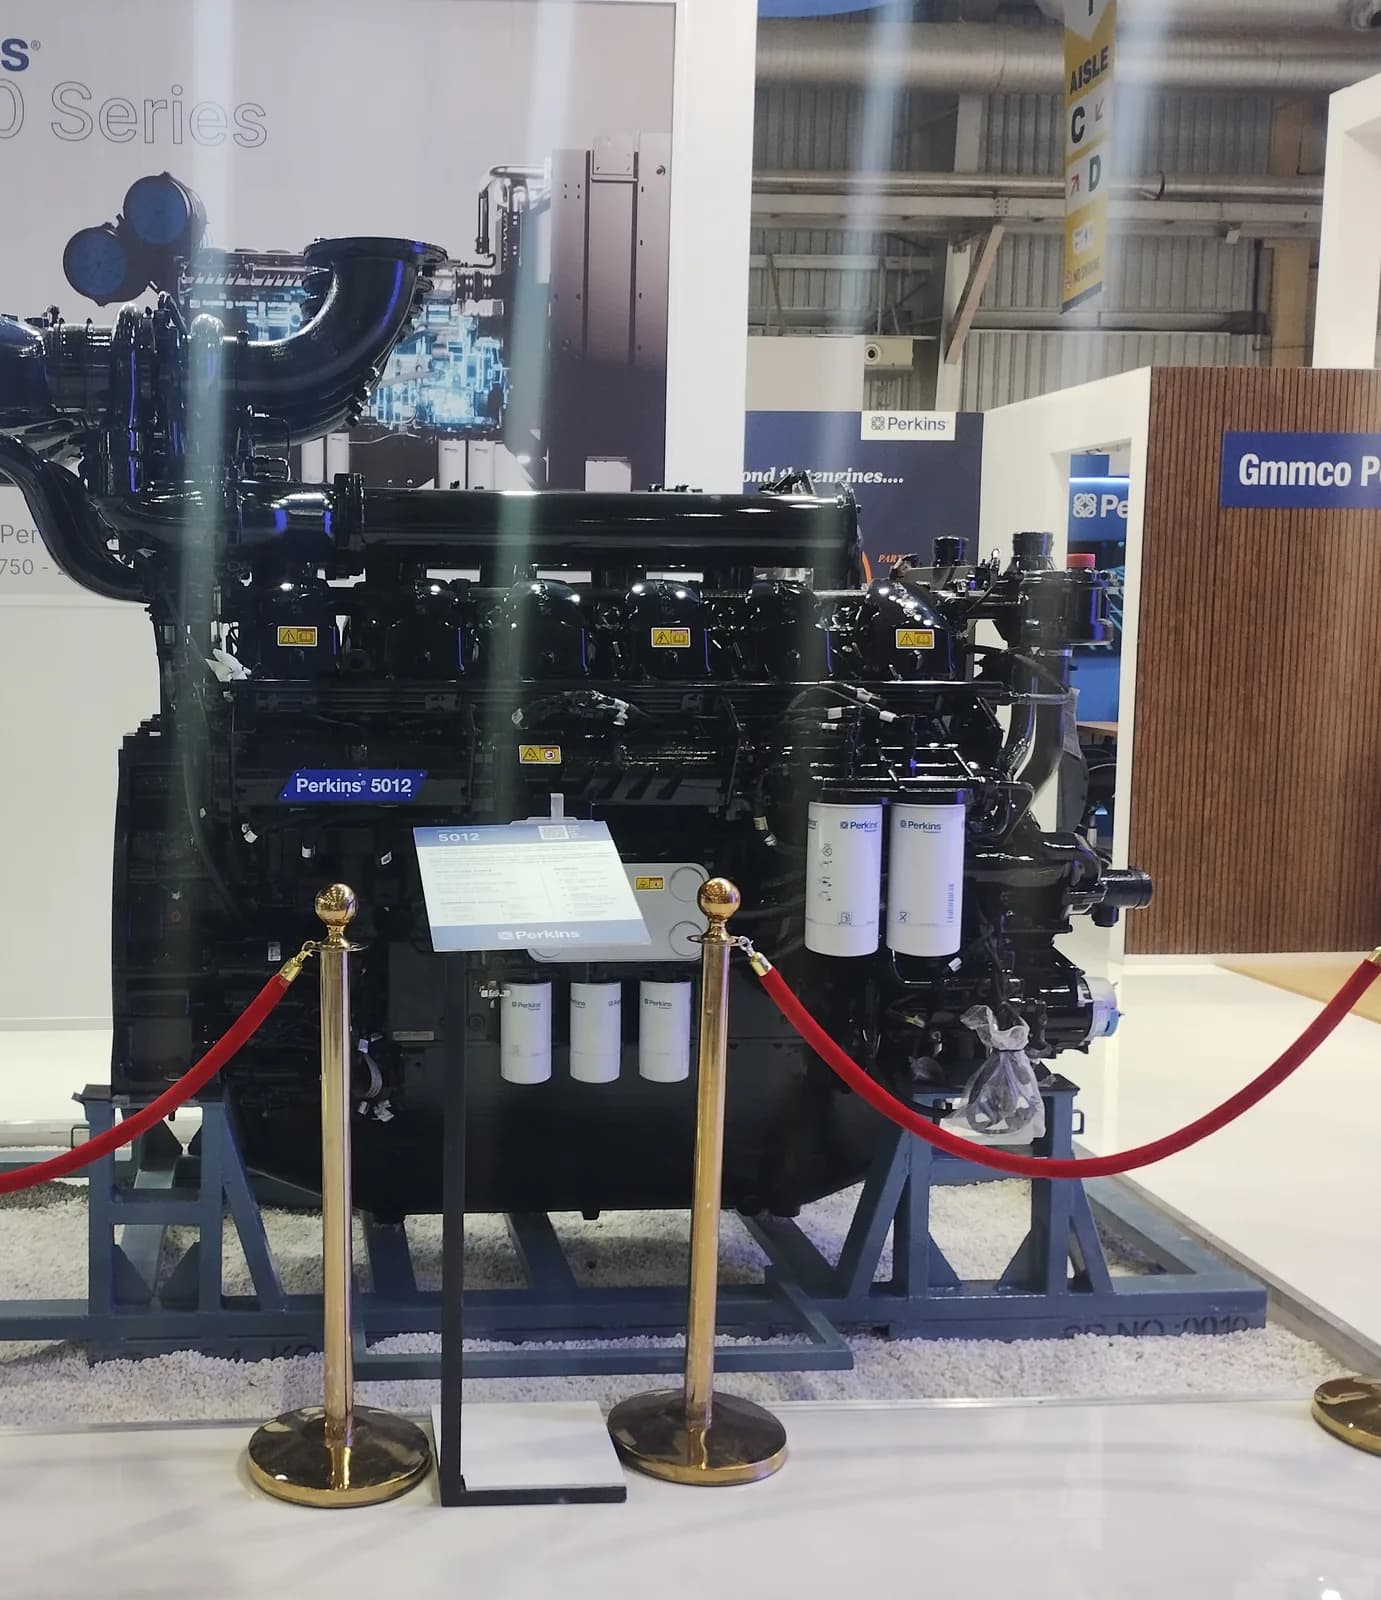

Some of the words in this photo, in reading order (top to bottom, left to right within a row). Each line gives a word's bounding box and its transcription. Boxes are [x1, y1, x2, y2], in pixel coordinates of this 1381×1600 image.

[1070, 45, 1109, 96] AISLE
[51, 81, 268, 148] Series
[1071, 106, 1086, 143] C
[1088, 154, 1102, 192] D
[887, 416, 947, 431] Perkins
[1239, 453, 1352, 487] Gmmco
[1360, 455, 1381, 487] P
[296, 778, 362, 793] Perkins
[370, 778, 412, 793] 5012
[438, 832, 480, 842] 5012
[907, 820, 942, 831] Perkins
[515, 930, 580, 941] Perkins
